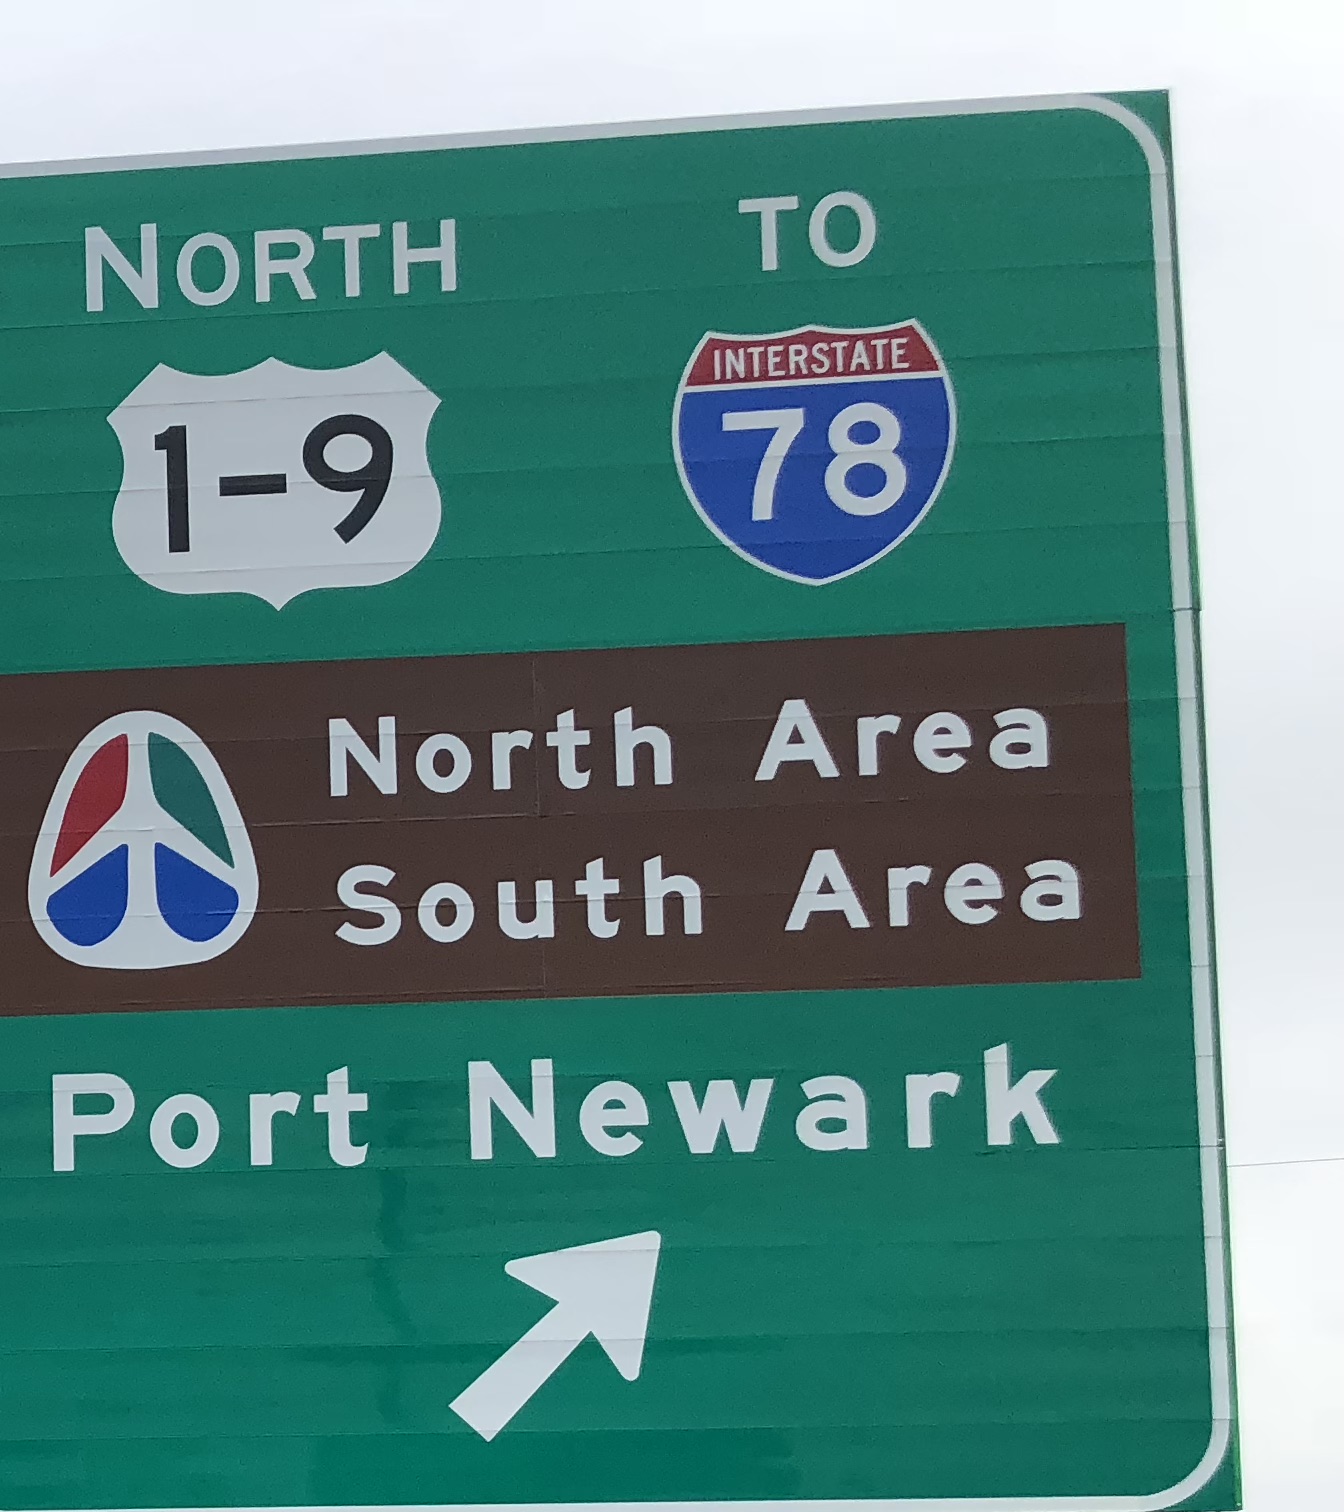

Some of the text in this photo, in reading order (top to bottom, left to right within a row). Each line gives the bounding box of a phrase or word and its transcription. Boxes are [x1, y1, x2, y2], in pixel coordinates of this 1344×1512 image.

[84, 218, 457, 312] NORTH
[737, 190, 877, 271] TO
[713, 337, 910, 380] INTERSTATE
[154, 413, 394, 553] 1-9
[721, 402, 907, 522] 78
[328, 698, 1051, 798] North Area
[334, 848, 1084, 947] South Area
[51, 1041, 1060, 1172] Port Newark
